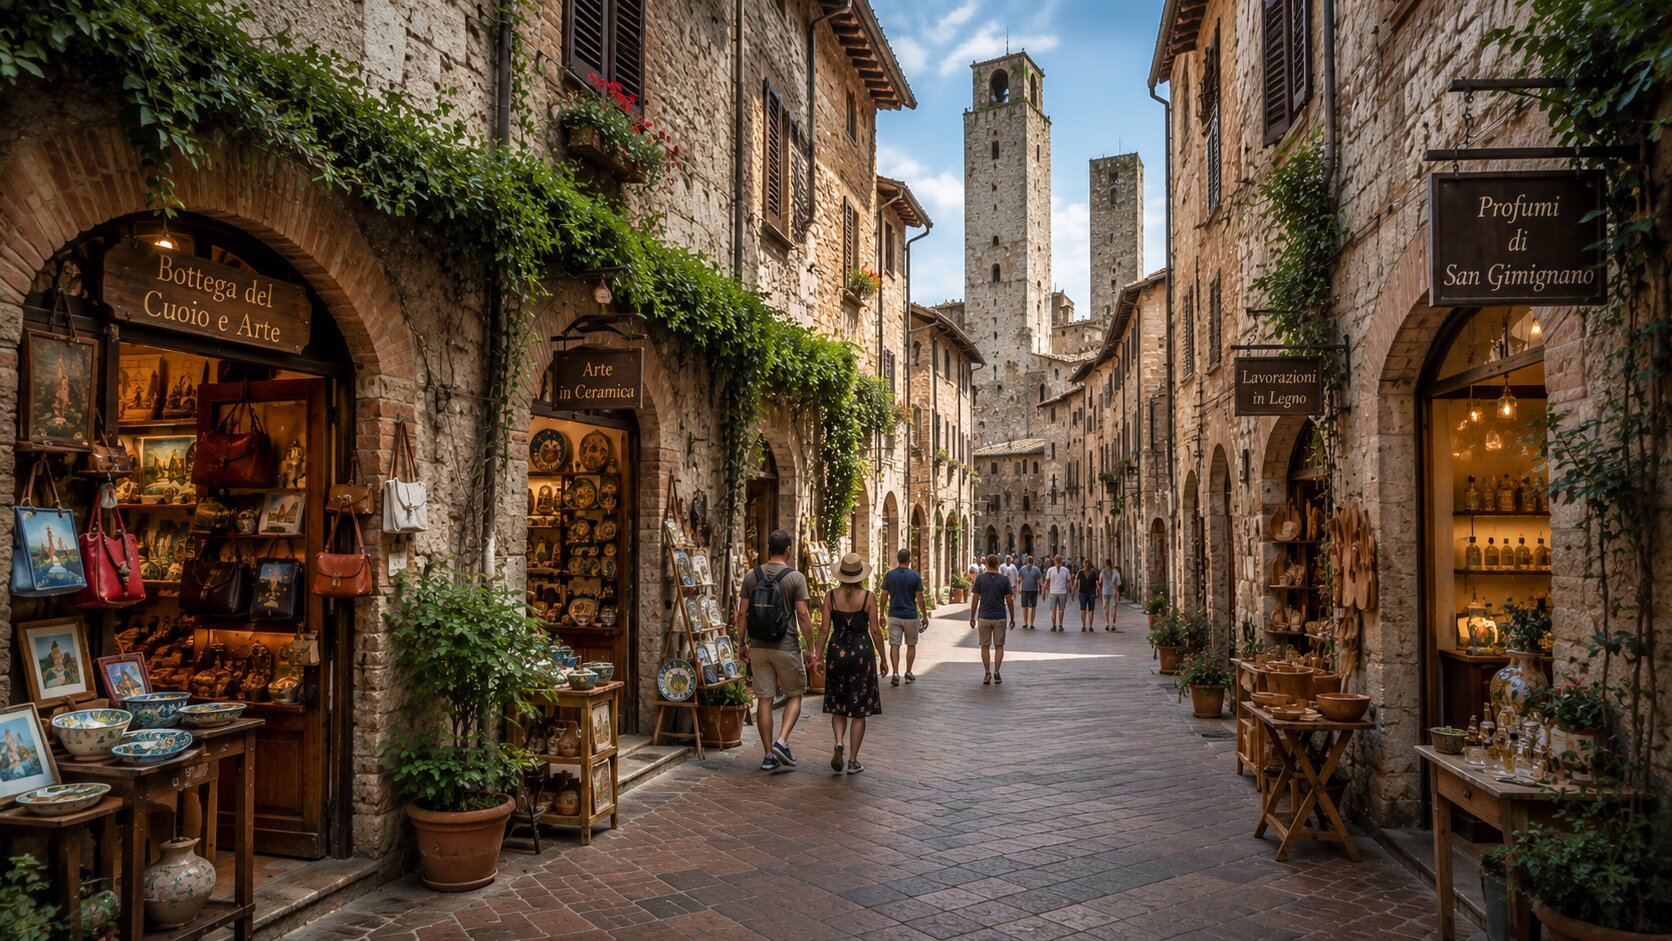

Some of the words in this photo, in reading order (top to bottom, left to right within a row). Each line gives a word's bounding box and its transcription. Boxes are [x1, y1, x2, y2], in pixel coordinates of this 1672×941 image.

[1477, 194, 1560, 224] Profumi
[1508, 228, 1528, 252] di
[156, 254, 237, 303] Bottega
[245, 280, 273, 308] del
[1443, 263, 1481, 286] San
[1488, 263, 1595, 292] Gimignano
[143, 290, 210, 328] Cuoio
[218, 314, 229, 332] e
[236, 313, 281, 343] Arte
[582, 362, 613, 377] Arte
[1241, 369, 1317, 384] Lavorazioni
[559, 385, 571, 400] in
[575, 383, 635, 399] Ceramica
[1253, 391, 1265, 405] in
[1269, 390, 1307, 409] Legno
